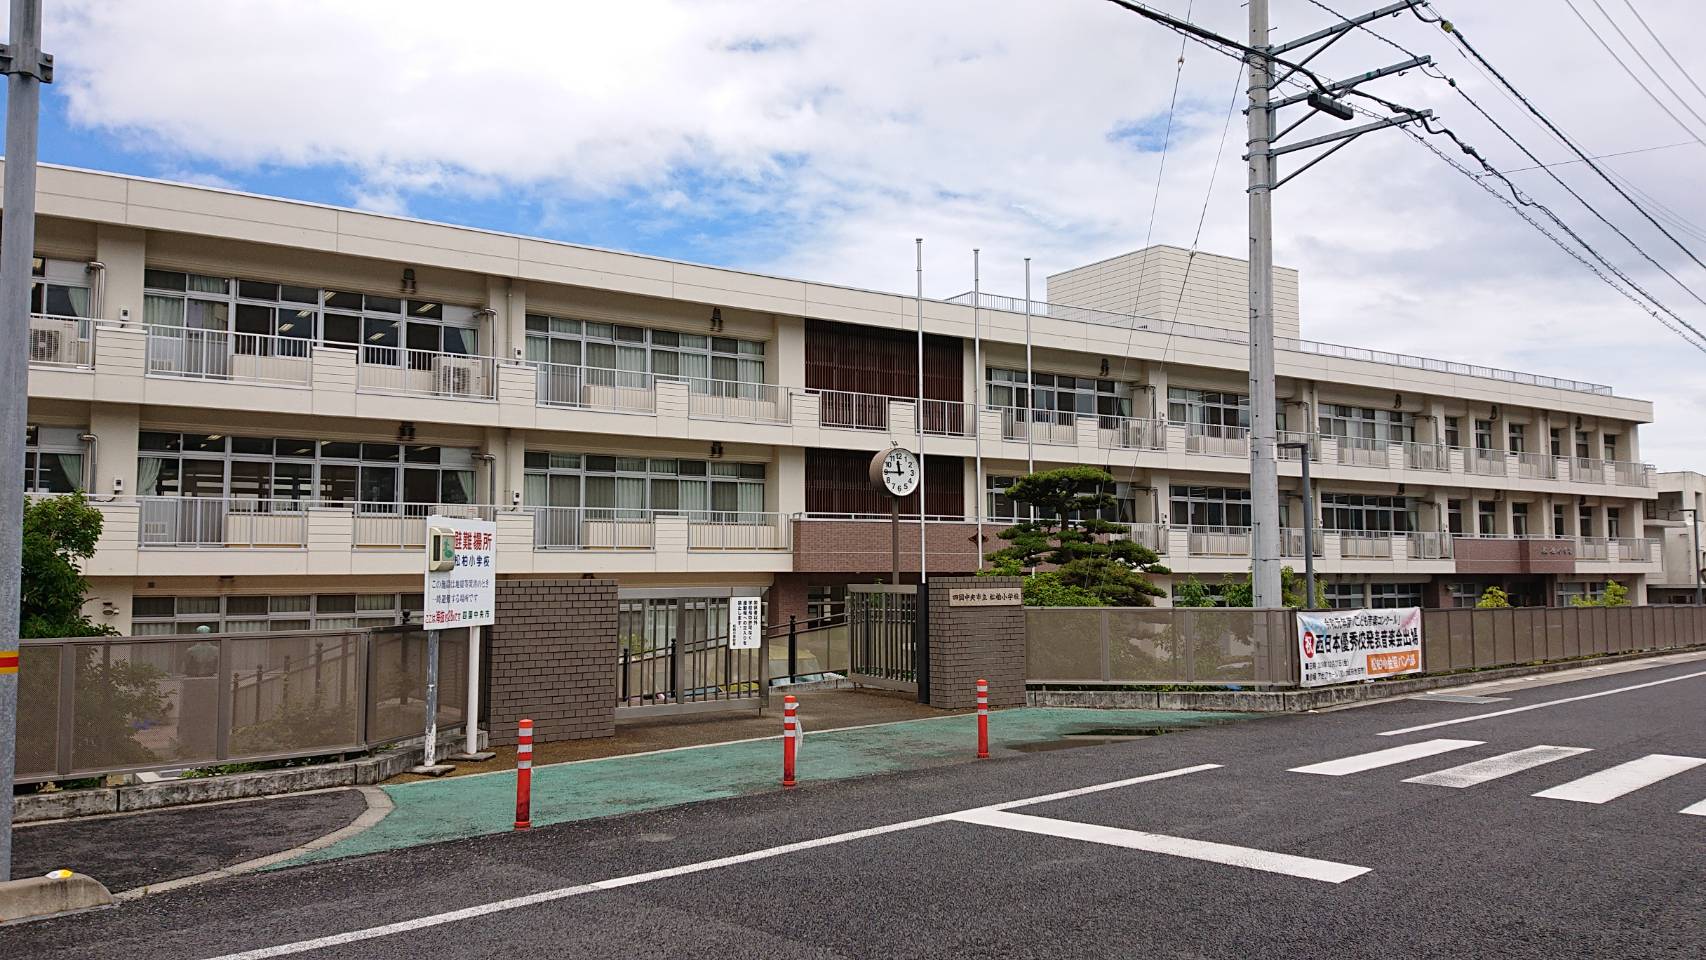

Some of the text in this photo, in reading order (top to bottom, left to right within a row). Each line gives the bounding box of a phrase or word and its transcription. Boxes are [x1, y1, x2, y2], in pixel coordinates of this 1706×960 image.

[462, 610, 490, 620] 四国中央市
[1305, 627, 1419, 655] 祝 西日本優秀校発表音楽会出場
